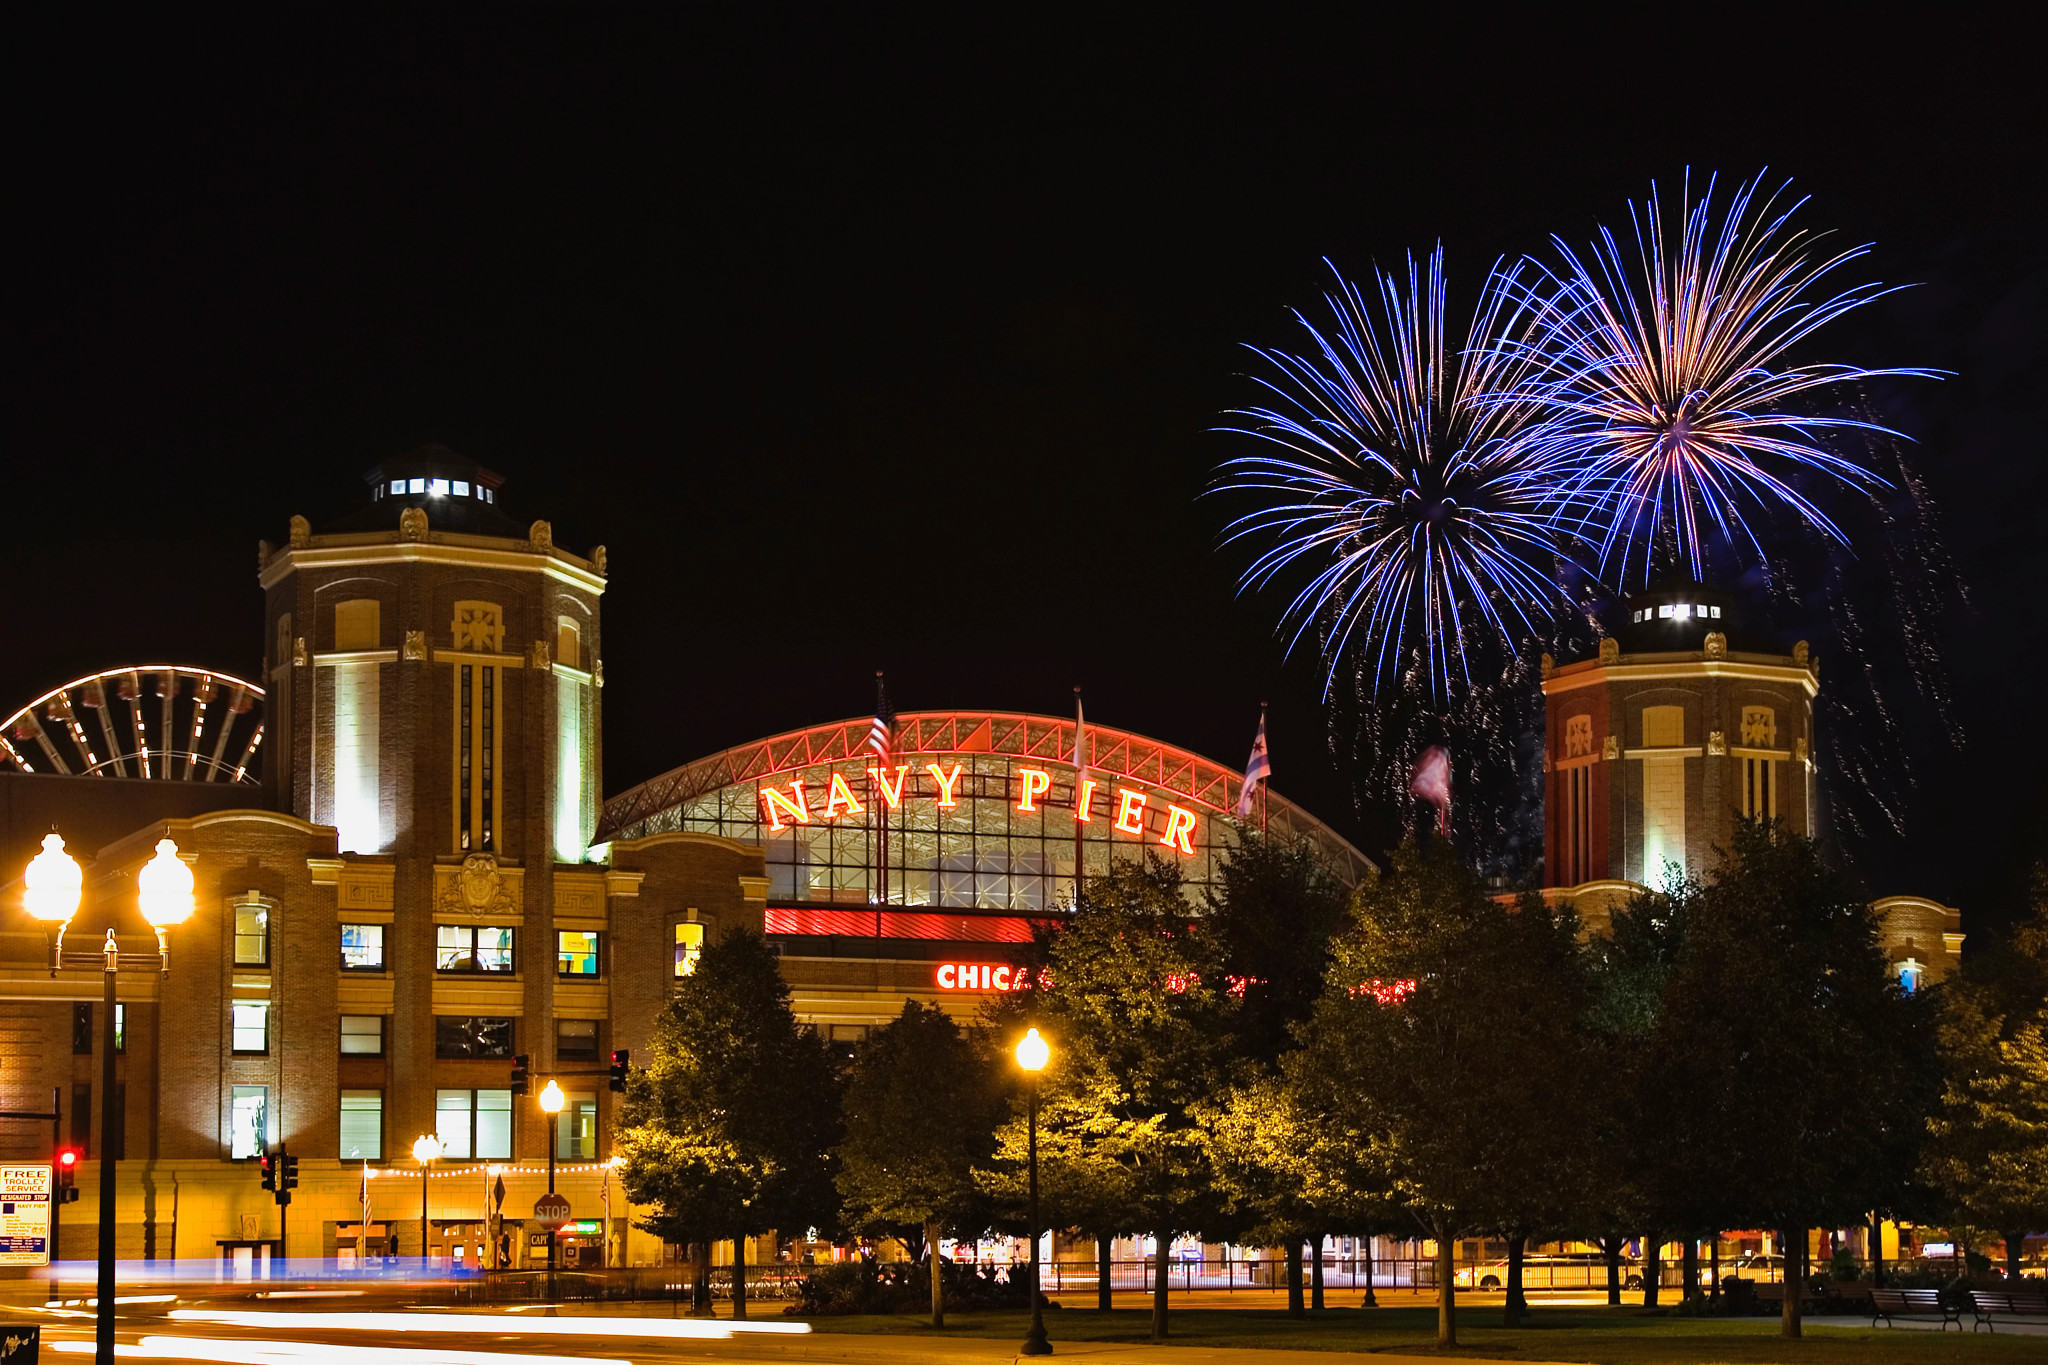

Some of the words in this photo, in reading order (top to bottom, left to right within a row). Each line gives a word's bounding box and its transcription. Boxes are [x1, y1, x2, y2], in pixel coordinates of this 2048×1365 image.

[760, 763, 963, 832] NAVY
[1016, 768, 1197, 855] PIER
[4, 1170, 47, 1178] FREE
[536, 1205, 569, 1219] STOP
